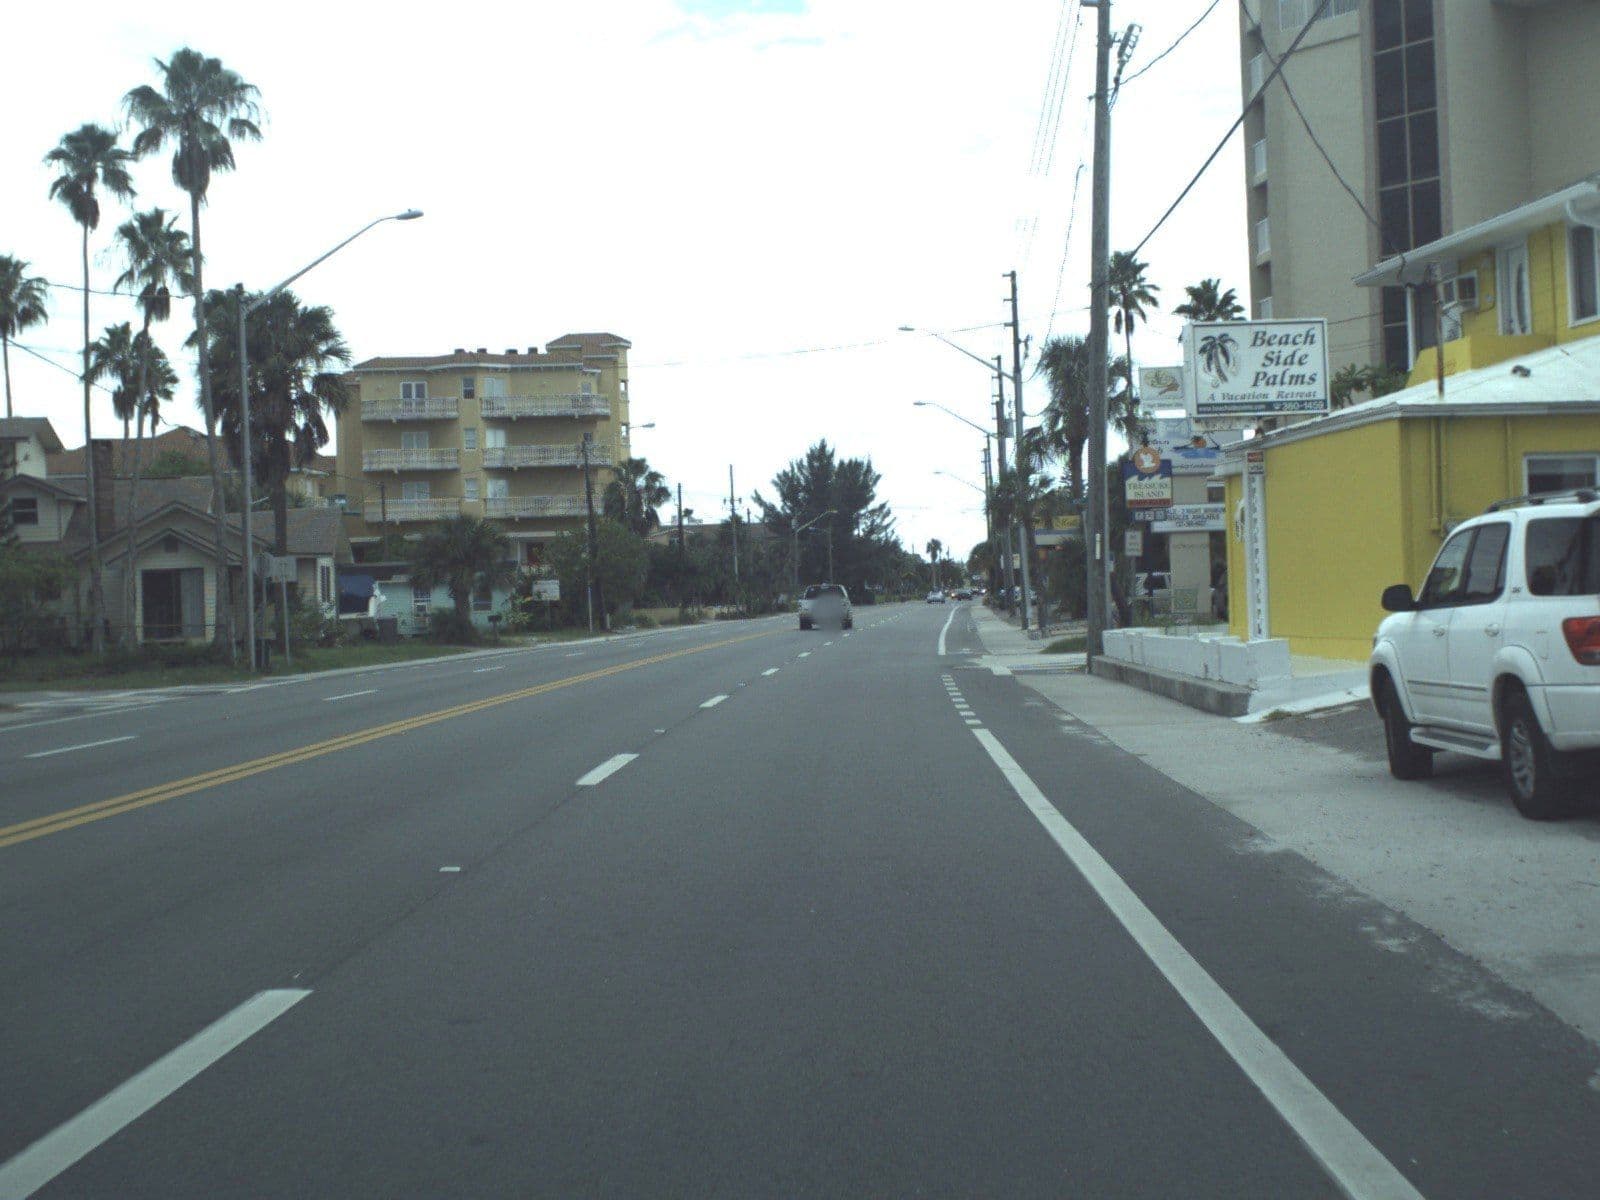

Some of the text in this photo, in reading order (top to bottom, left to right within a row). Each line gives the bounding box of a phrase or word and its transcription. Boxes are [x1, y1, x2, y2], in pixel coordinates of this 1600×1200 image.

[1251, 327, 1316, 347] Beach
[1262, 348, 1309, 367] Side
[1251, 368, 1317, 387] Palms
[1208, 390, 1317, 401] A Vacation Retreat
